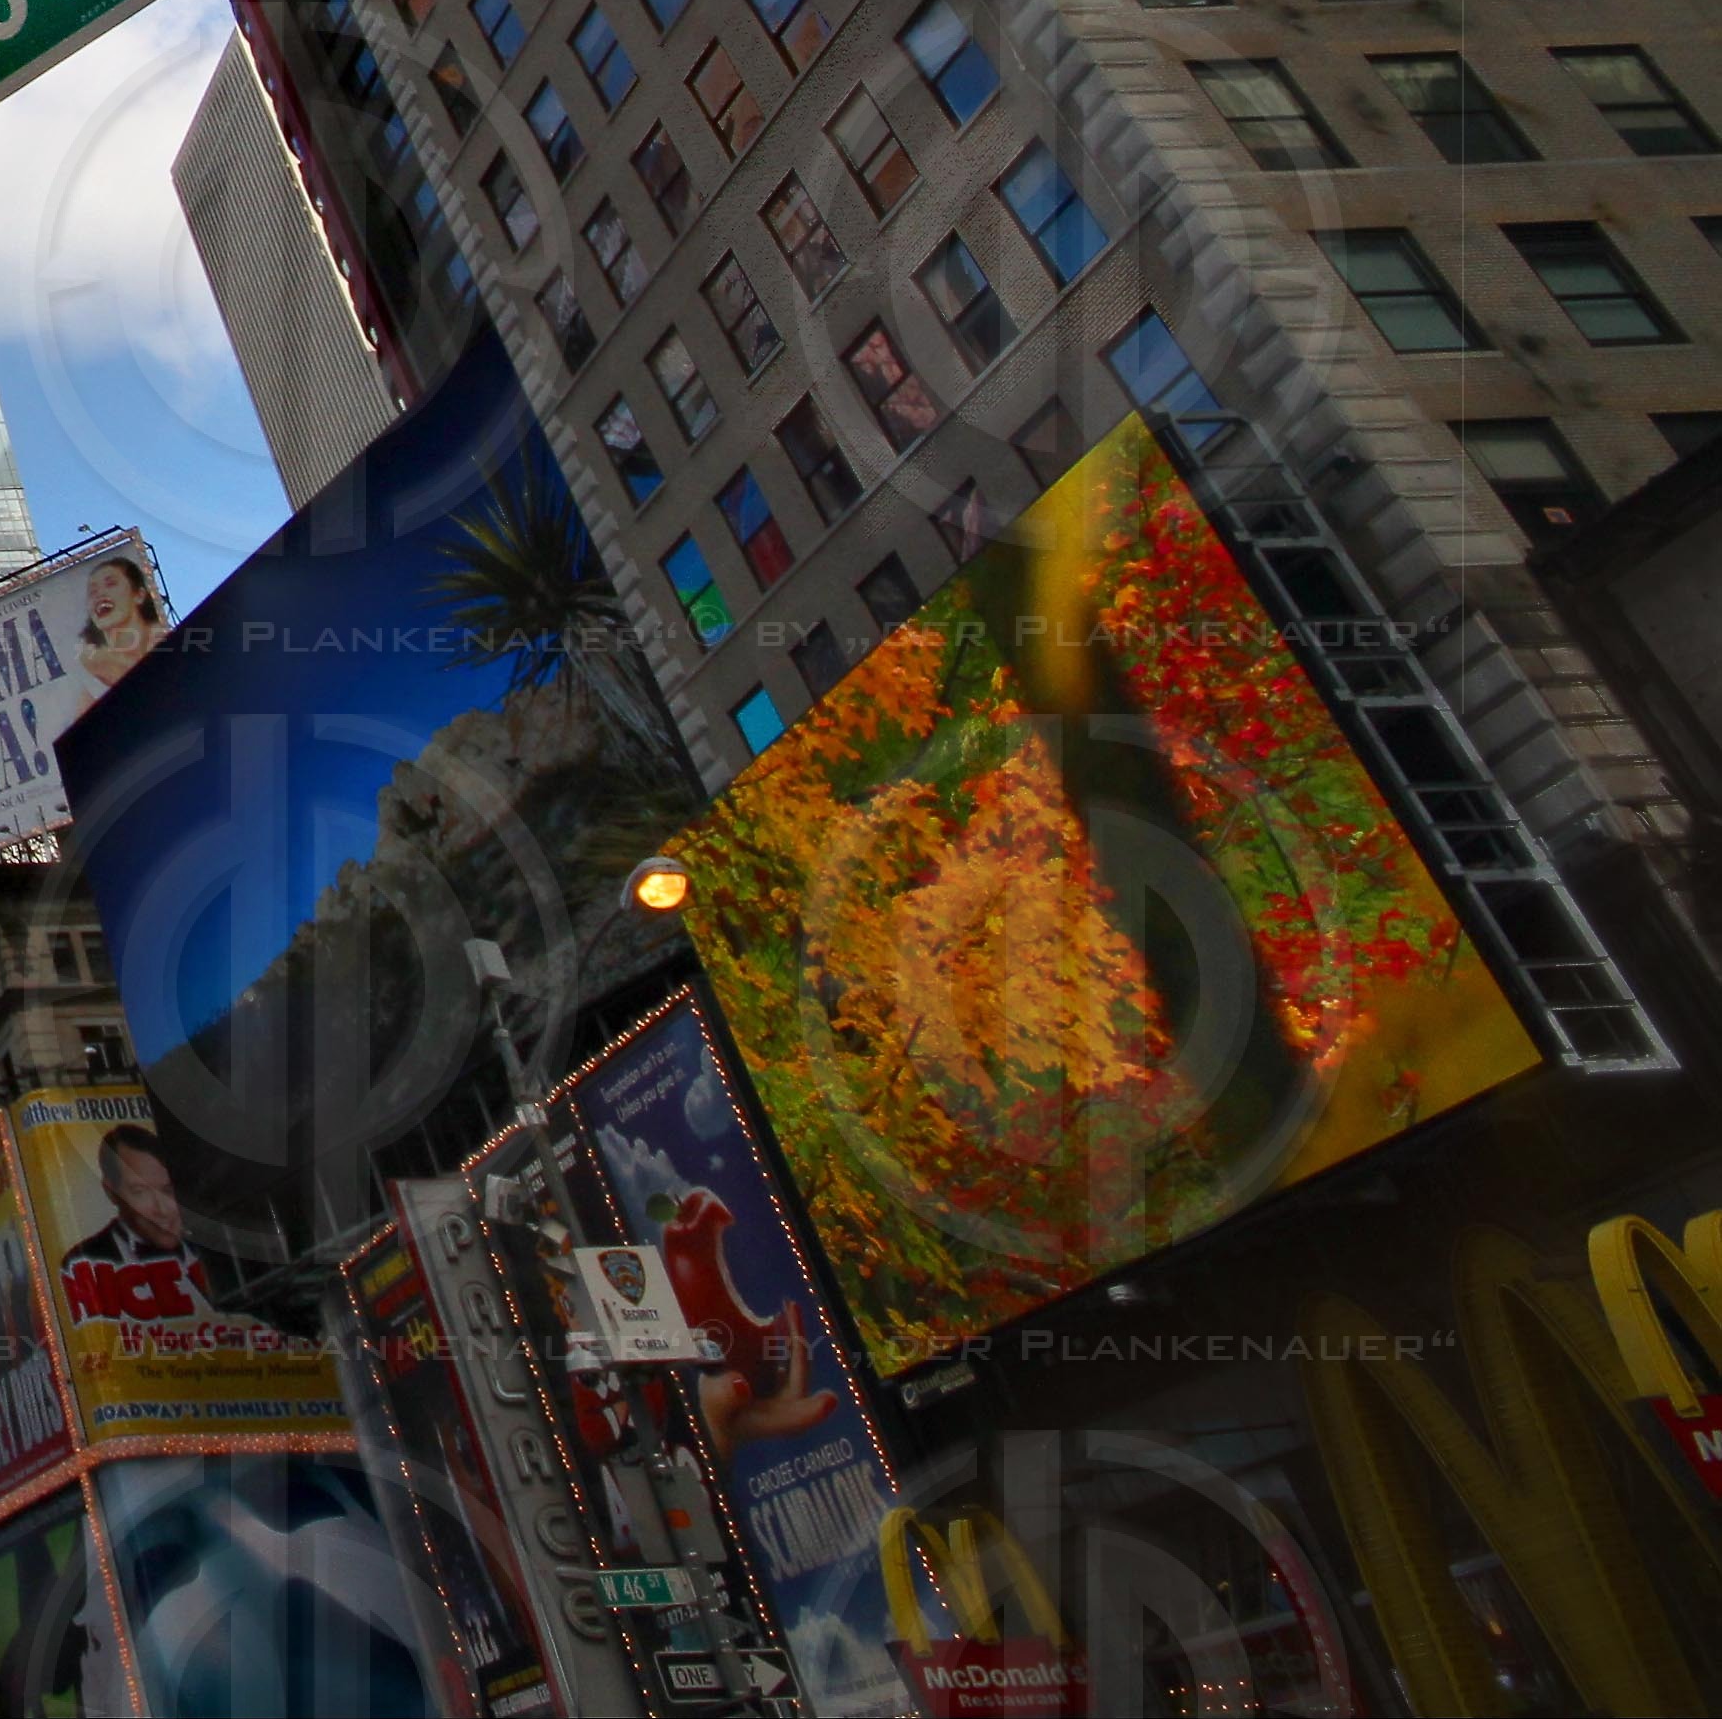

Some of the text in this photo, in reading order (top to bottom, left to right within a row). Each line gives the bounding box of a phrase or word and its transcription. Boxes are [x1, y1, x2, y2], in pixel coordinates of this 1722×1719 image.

[61, 1260, 195, 1325] NICE
[438, 1212, 607, 1642] PALACE
[599, 1574, 661, 1602] W 46 ST
[675, 1667, 714, 1686] ONE
[923, 1663, 1088, 1691] McDonald's
